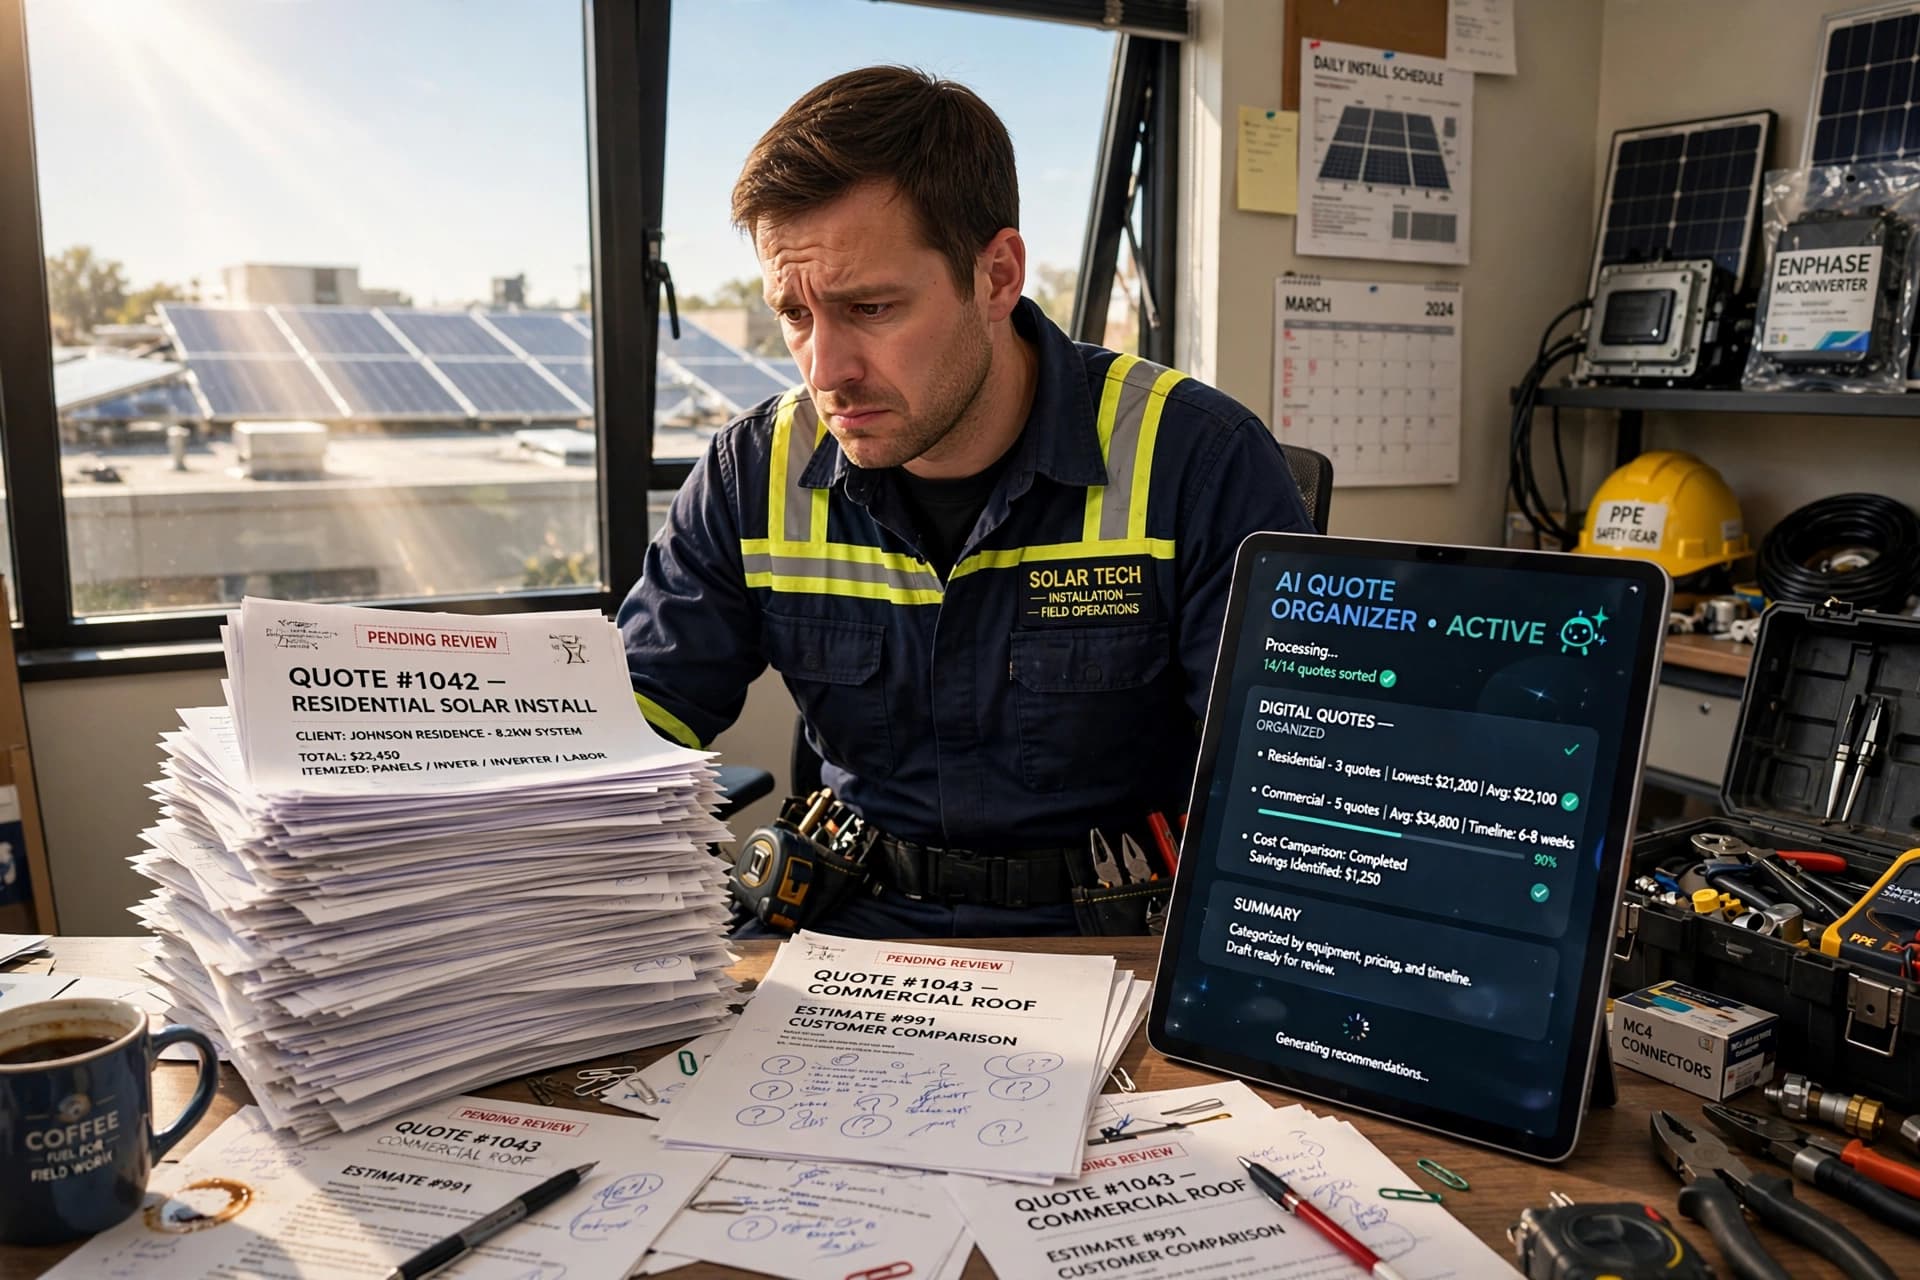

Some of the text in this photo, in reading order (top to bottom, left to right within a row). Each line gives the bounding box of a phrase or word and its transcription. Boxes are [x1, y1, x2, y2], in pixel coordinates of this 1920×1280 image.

[1314, 55, 1444, 87] DAILY INSTALL SCHEDULE
[1778, 253, 1872, 276] ENPHASE
[1775, 278, 1868, 295] MICROINVERTER
[1285, 296, 1454, 317] MARCH 2024
[1610, 505, 1645, 525] PPE
[1596, 527, 1658, 545] SAFETY GEAR
[1029, 565, 1142, 589] SOLAR TECH
[1276, 570, 1396, 602] AI QUOTE
[1049, 589, 1123, 603] INSTALLATION
[1041, 603, 1140, 618] FIELD OPERATIONS
[1271, 598, 1546, 645] ORGANIZER ACTIVE
[367, 630, 498, 649] PENDING REVIEW
[1265, 637, 1339, 660] Processing...
[289, 667, 388, 689] QUOTE
[397, 671, 480, 690] #1042
[1263, 658, 1376, 683] 14/14 quotes sorted
[292, 695, 597, 713] RESIDENTIAL SOLAR INSTALL
[1259, 700, 1313, 720] DIGITAL
[1316, 708, 1376, 729] QUOTES
[296, 730, 346, 741] CLIENT:
[349, 730, 413, 741] JOHNSON
[416, 728, 483, 740] RESIDENCE
[534, 727, 582, 738] SYSTEM
[1256, 719, 1325, 740] ORGANIZED
[298, 750, 400, 762] TOTAL: $22,450
[302, 764, 370, 776] ITEMIZED:
[372, 761, 423, 773] PANELS
[433, 758, 479, 769] INVETR
[490, 755, 552, 767] INVERTER
[563, 752, 607, 762] LABOR
[1268, 748, 1326, 770] Residential
[1335, 760, 1343, 772] 3
[1344, 764, 1382, 778] quotes
[1392, 768, 1433, 786] Lowest:
[1435, 775, 1479, 793] $21,200
[1486, 783, 1511, 801] Avg:
[1513, 787, 1558, 805] $22,100
[1261, 784, 1325, 807] Commercial
[1335, 797, 1343, 810] 5
[1344, 801, 1380, 817] quotes
[1389, 809, 1414, 825] Avg:
[1415, 811, 1460, 831] $34,800
[1468, 819, 1517, 840] Timeline:
[1518, 828, 1539, 844] 6-8
[1540, 834, 1575, 850] weeks
[1253, 831, 1278, 848] Cost
[1349, 850, 1408, 871] Completed
[1533, 853, 1558, 868] 90%
[1249, 850, 1381, 886] Savings Identified: $1,250
[1233, 896, 1302, 922] SUMMARY
[1849, 932, 1878, 948] PPE
[886, 954, 1003, 971] PENDING REVIEW
[1226, 940, 1336, 976] Draft ready for review.
[1229, 922, 1472, 987] Categorized by equipment, pricing, and timeline.
[813, 969, 896, 987] QUOTE
[903, 976, 973, 992] #1043
[807, 983, 1037, 1012] COMMERCIAL ROOF
[794, 1005, 936, 1027] ESTIMATE #991
[1623, 1017, 1653, 1040] MC4
[788, 1017, 888, 1036] CUSTOMER
[892, 1026, 1018, 1047] COMPARISON
[1276, 1031, 1430, 1082] Generating recommendations...
[1621, 1036, 1712, 1080] CONNECTORS
[26, 1110, 119, 1151] COFFEE
[460, 1109, 575, 1133] PENDING REVIEW
[395, 1121, 542, 1152] QUOTE #1043
[47, 1139, 103, 1163] FUEL FOR
[377, 1135, 536, 1167] COMMERCIAL ROOF
[1082, 1147, 1174, 1172] DING REVIEW
[31, 1150, 112, 1182] FIELD WORK
[342, 1164, 473, 1194] ESTIMATE #991
[1015, 1185, 1099, 1213] QUOTE
[1104, 1173, 1175, 1197] #1043
[1027, 1178, 1248, 1231] COMMERCIAL ROOF
[1047, 1226, 1187, 1264] ESTIMATE #991
[1058, 1250, 1163, 1280] CUSTOMER
[1165, 1224, 1286, 1257] COMPARISON
